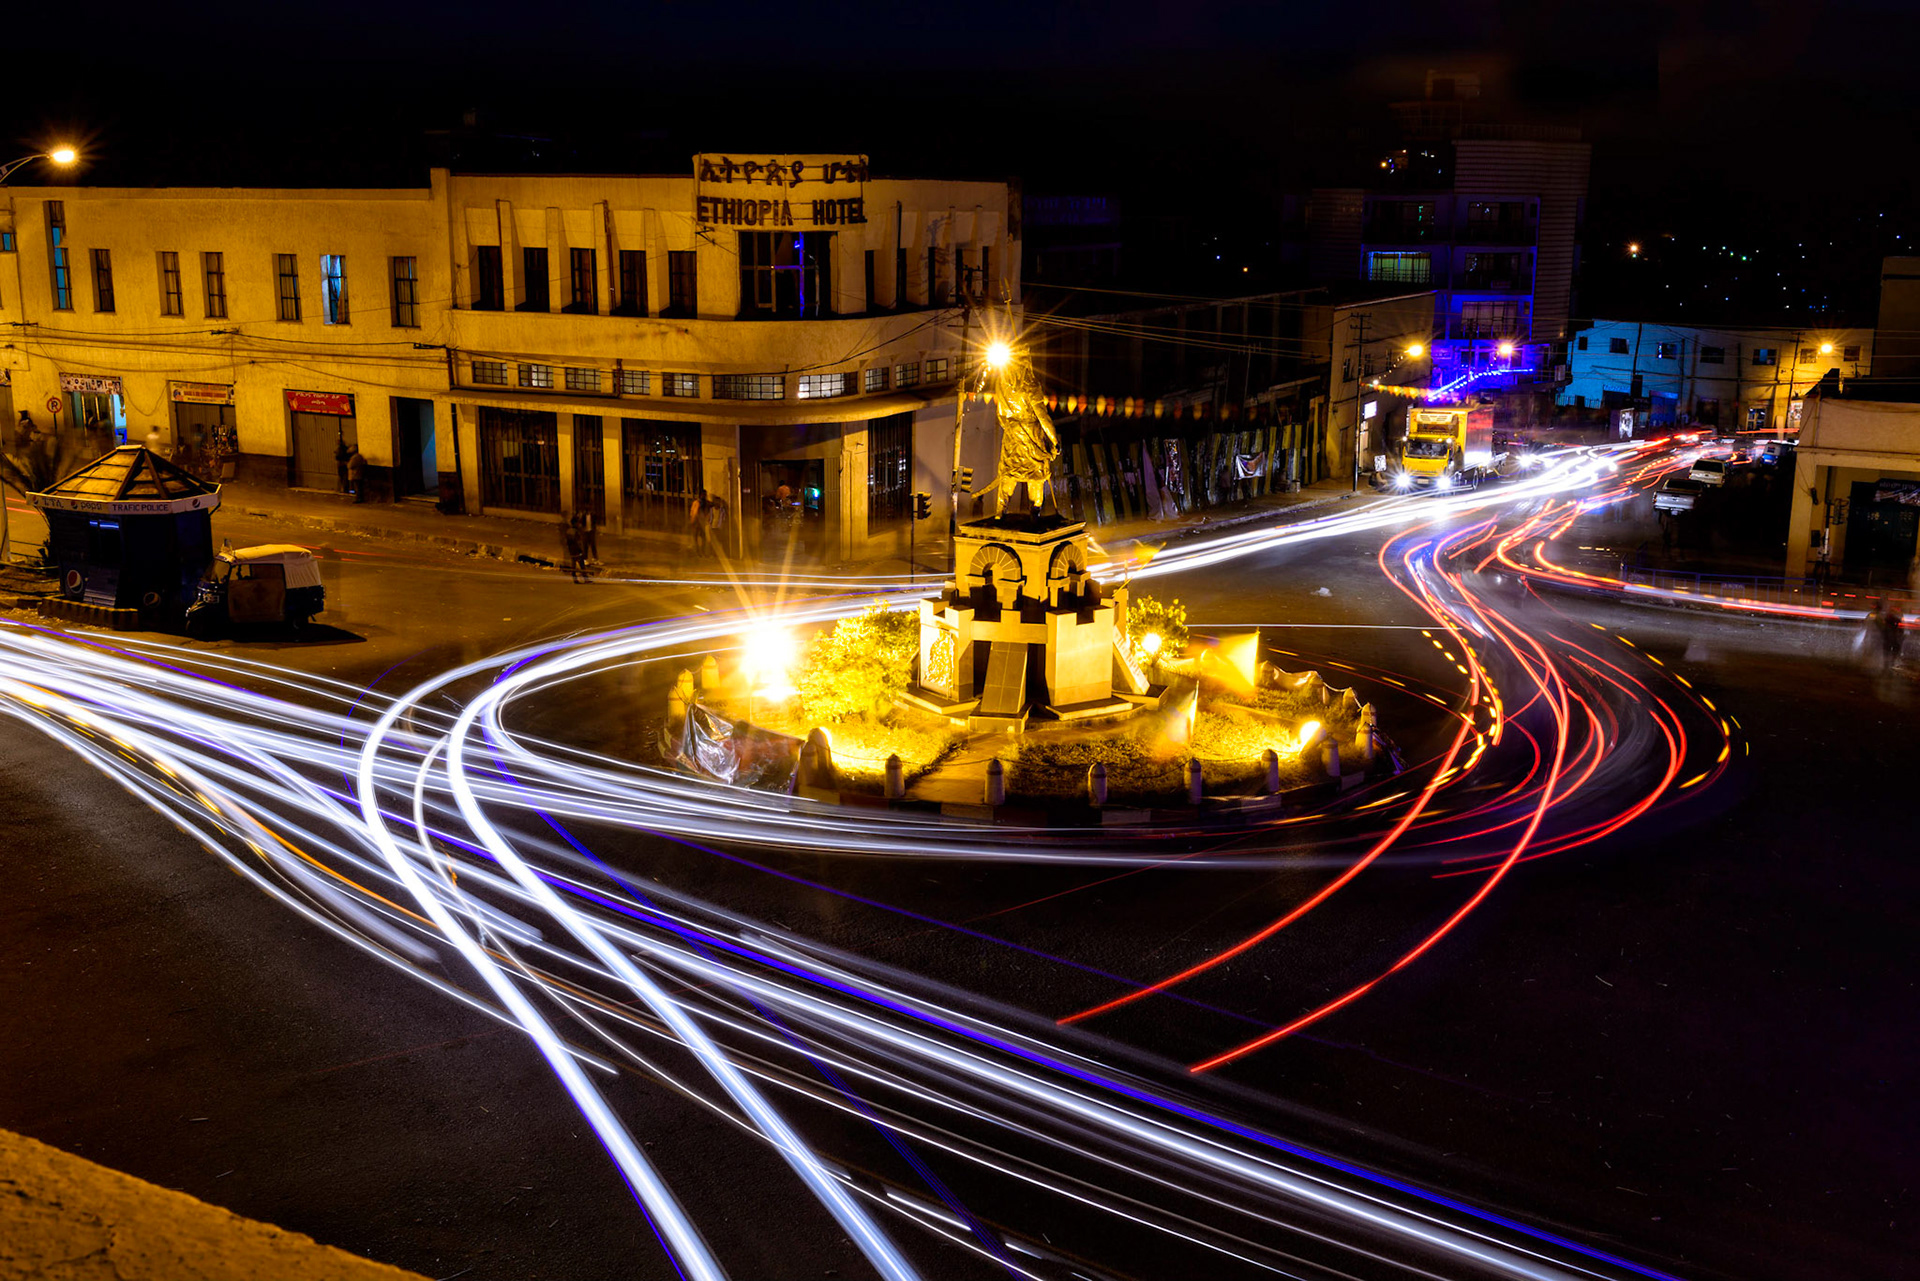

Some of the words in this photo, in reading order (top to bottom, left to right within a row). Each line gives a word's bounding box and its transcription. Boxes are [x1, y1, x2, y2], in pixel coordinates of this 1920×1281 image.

[696, 195, 794, 226] ETHIOPIA
[812, 197, 868, 226] HOTEL
[113, 504, 140, 512] TRAFIC
[141, 504, 168, 512] POLICE
